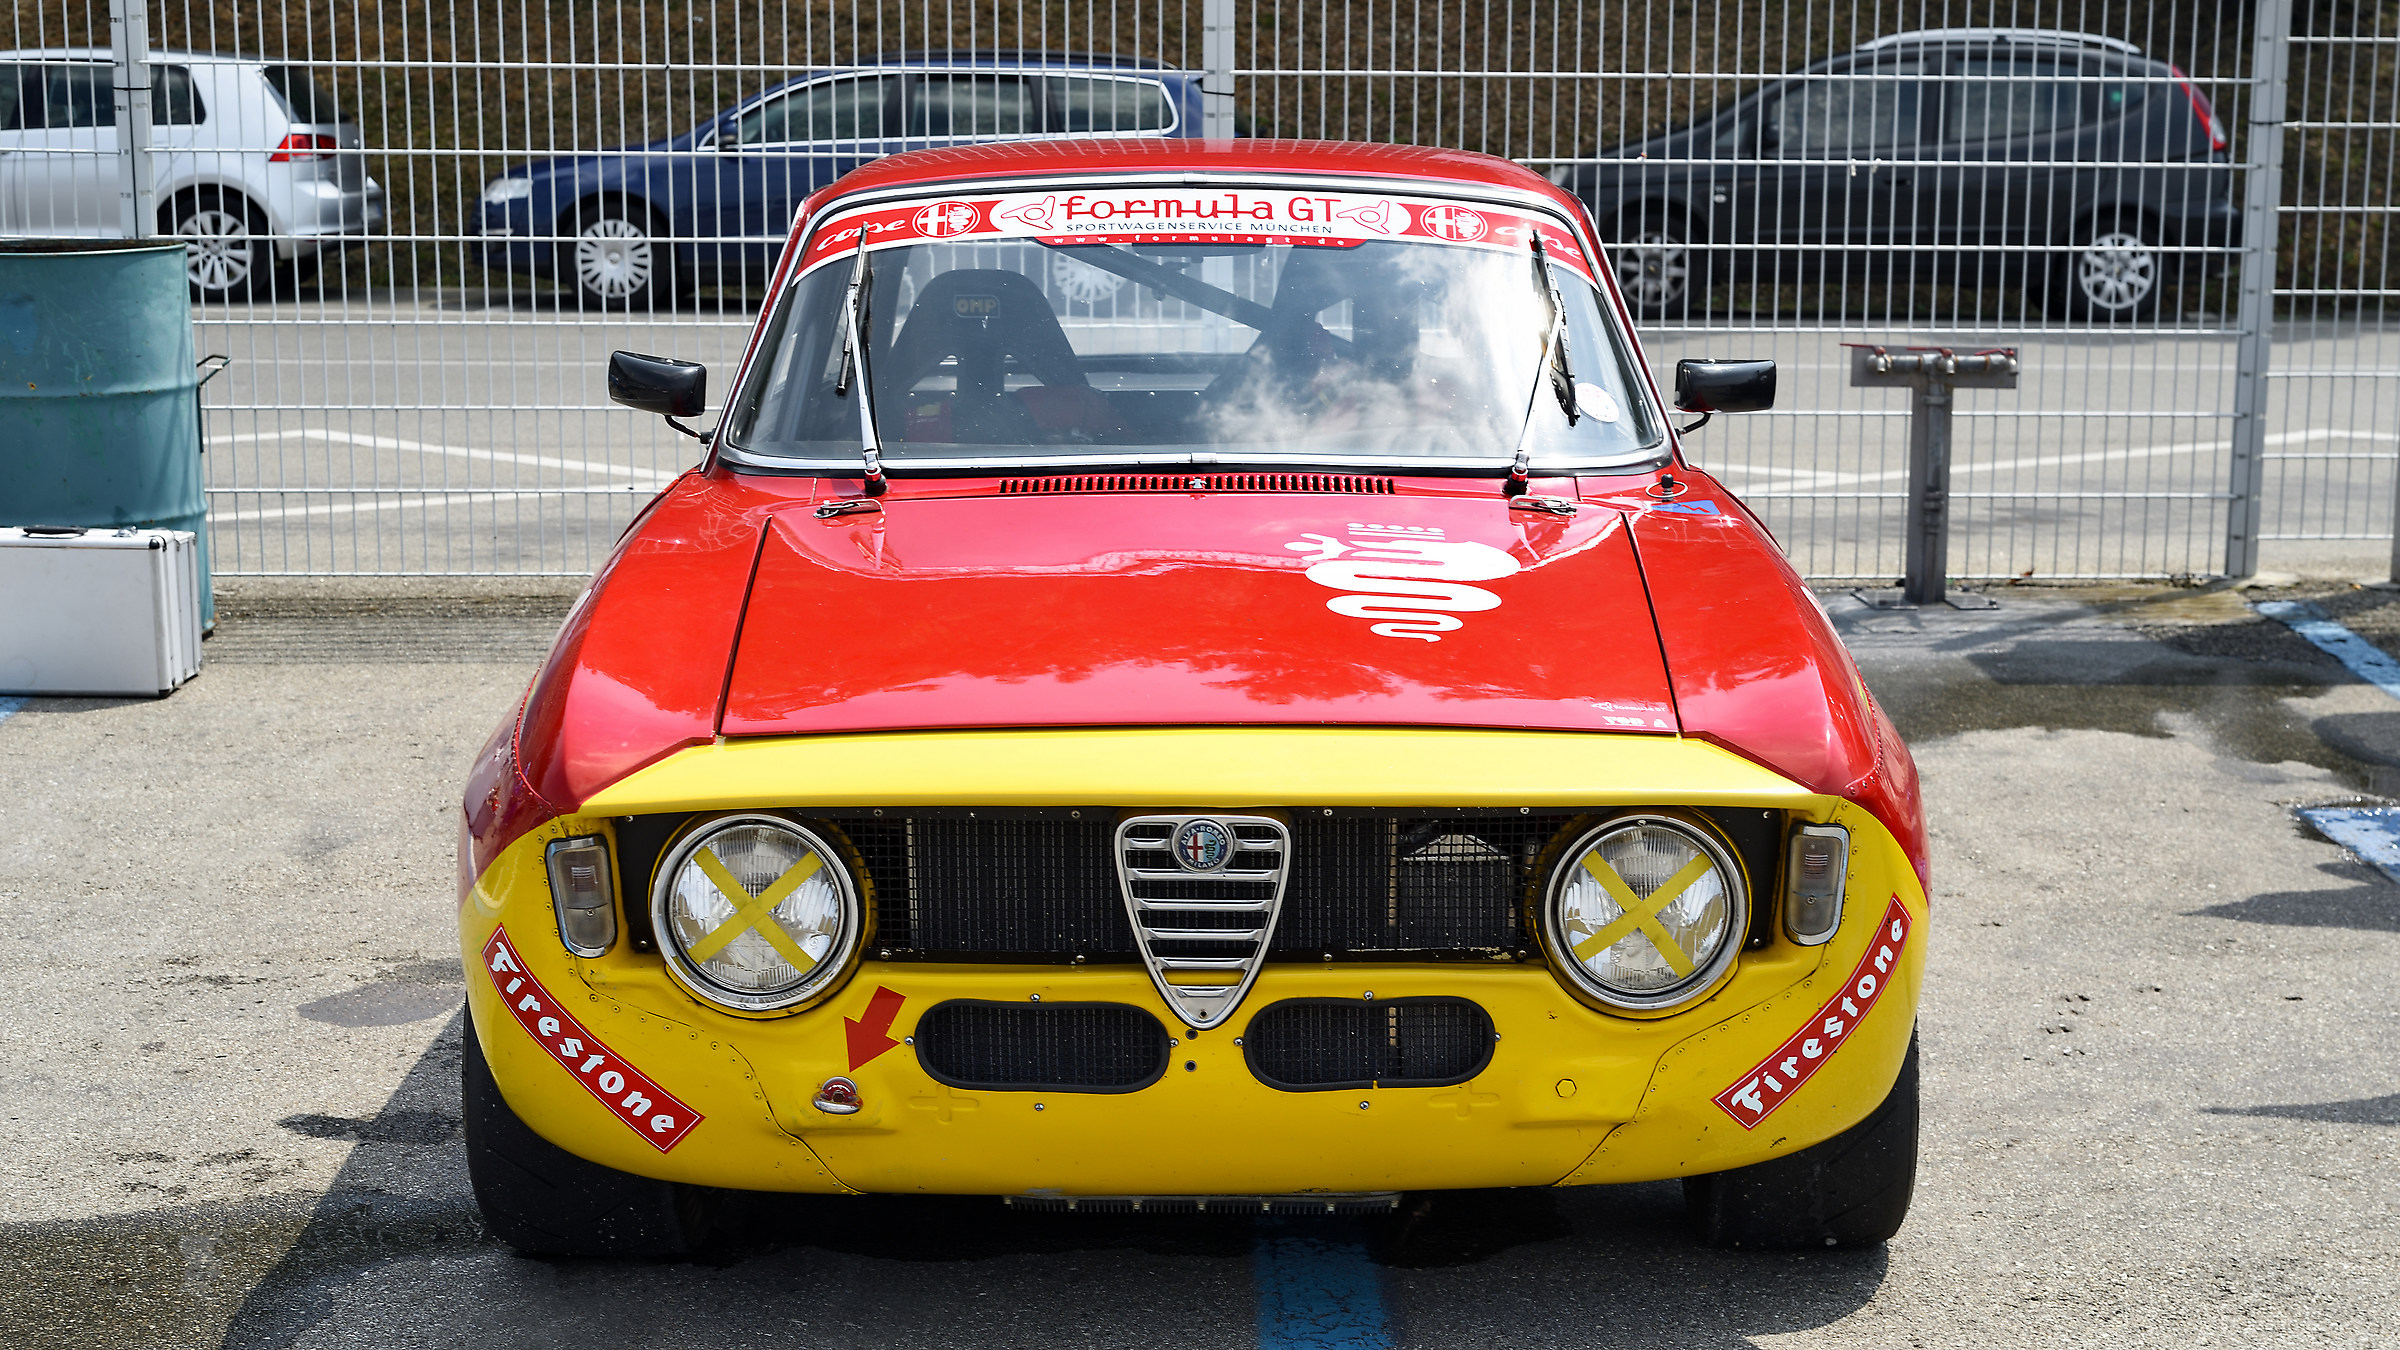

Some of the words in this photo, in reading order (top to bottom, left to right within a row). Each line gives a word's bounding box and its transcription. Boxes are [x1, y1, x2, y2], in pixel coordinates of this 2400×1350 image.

[1060, 194, 1273, 220] formula
[1288, 197, 1341, 222] GT
[1066, 222, 1242, 232] SPORTWAGENSERVICE
[1250, 222, 1332, 234] MÜNCHEN
[956, 298, 997, 313] OMP
[1187, 858, 1220, 868] MILANO
[1730, 918, 1903, 1115] Firestone
[490, 941, 675, 1133] Firestone
